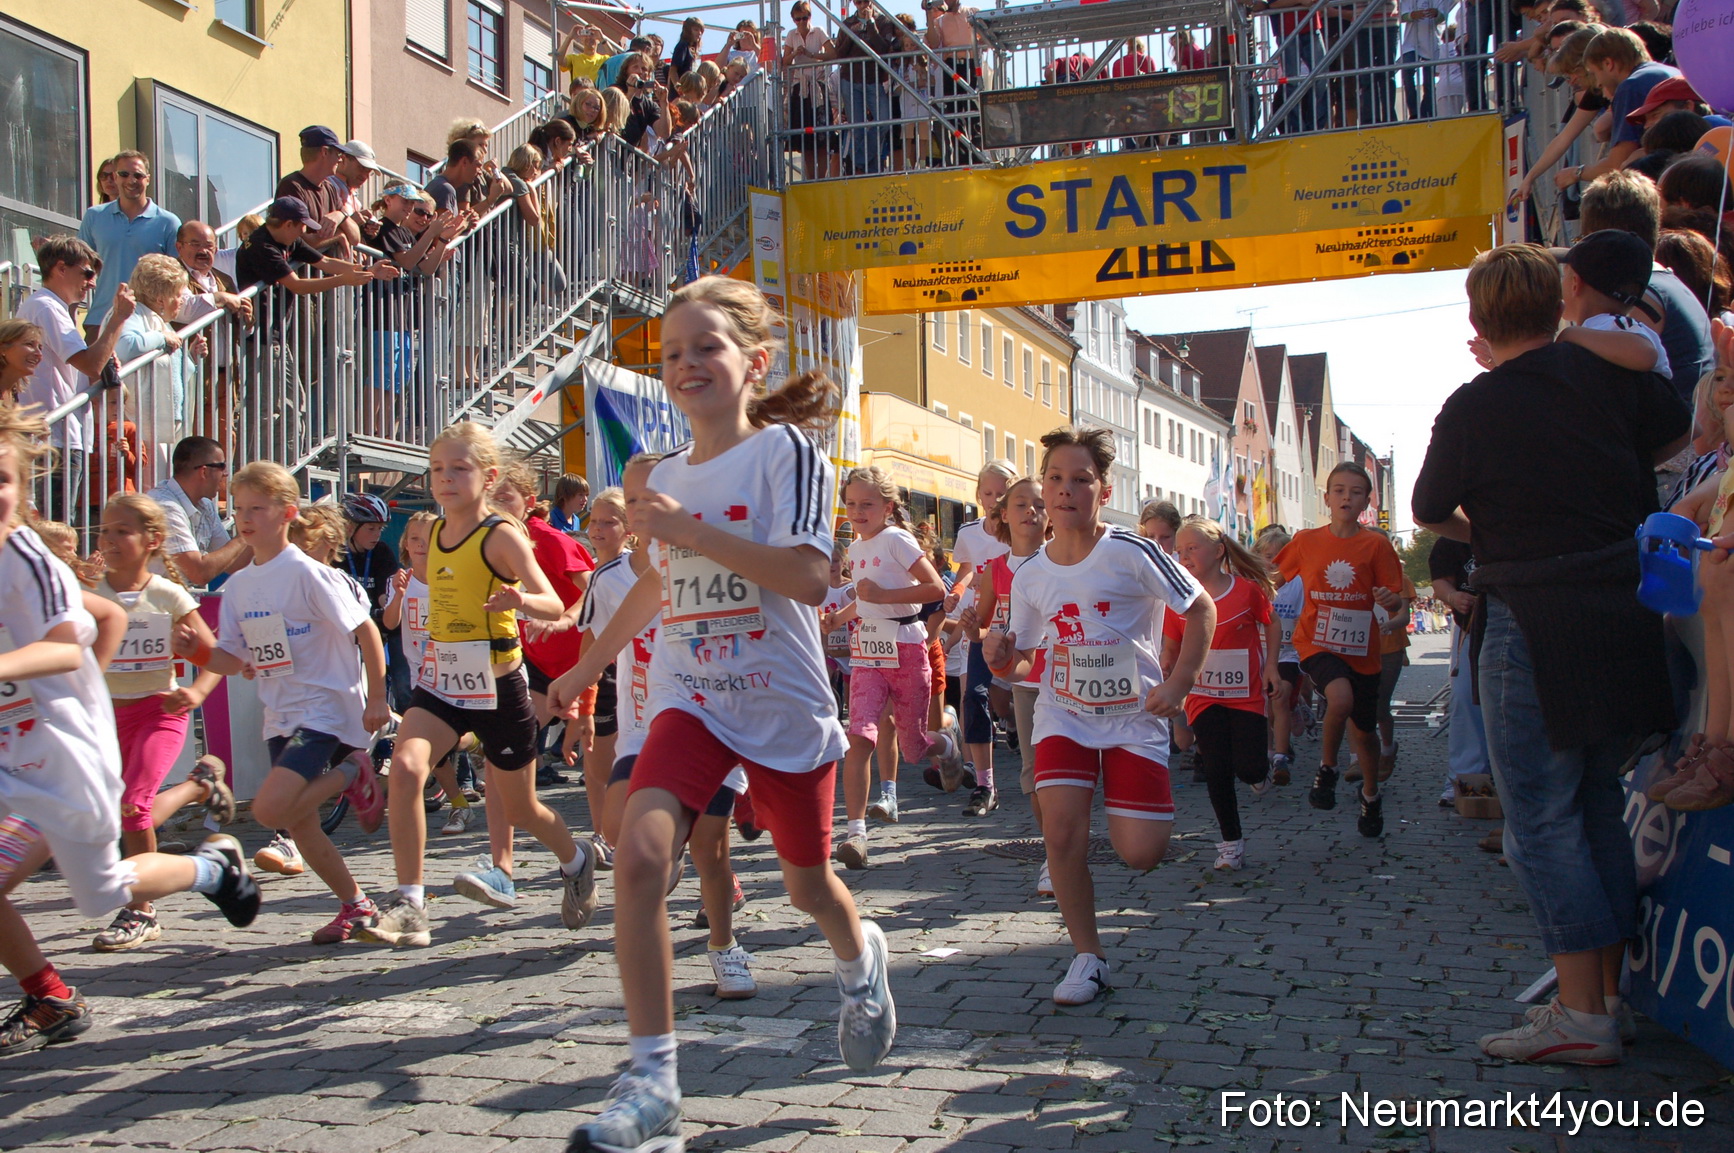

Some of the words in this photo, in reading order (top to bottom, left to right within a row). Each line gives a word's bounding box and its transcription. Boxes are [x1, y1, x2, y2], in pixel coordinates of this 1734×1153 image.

[1691, 18, 1715, 34] lebe
[1057, 81, 1110, 96] Elektronische
[1114, 73, 1217, 91] Sportstätteneinrichtungen
[1293, 182, 1383, 201] Neumarkter
[1386, 172, 1458, 193] Stadtlauf
[1004, 164, 1247, 238] START
[823, 224, 899, 241] Neumarkter
[903, 219, 964, 236] Stadtlauf
[1315, 238, 1391, 254] Neumarkter
[1396, 231, 1458, 247] Stadtlauf
[893, 275, 961, 288] Neumarkter
[965, 270, 1019, 284] Stadtlauf
[674, 573, 747, 608] 7146
[1310, 590, 1342, 601] MERZ
[830, 635, 849, 645] 704
[1331, 627, 1366, 643] 7113
[119, 638, 165, 655] 7165
[861, 640, 894, 654] 7088
[436, 648, 457, 665] Tanja
[1072, 653, 1115, 669] Isabelle
[441, 671, 487, 690] 7161
[1054, 671, 1066, 683] K3
[1205, 670, 1244, 685] 7189
[1074, 677, 1132, 698] 7039
